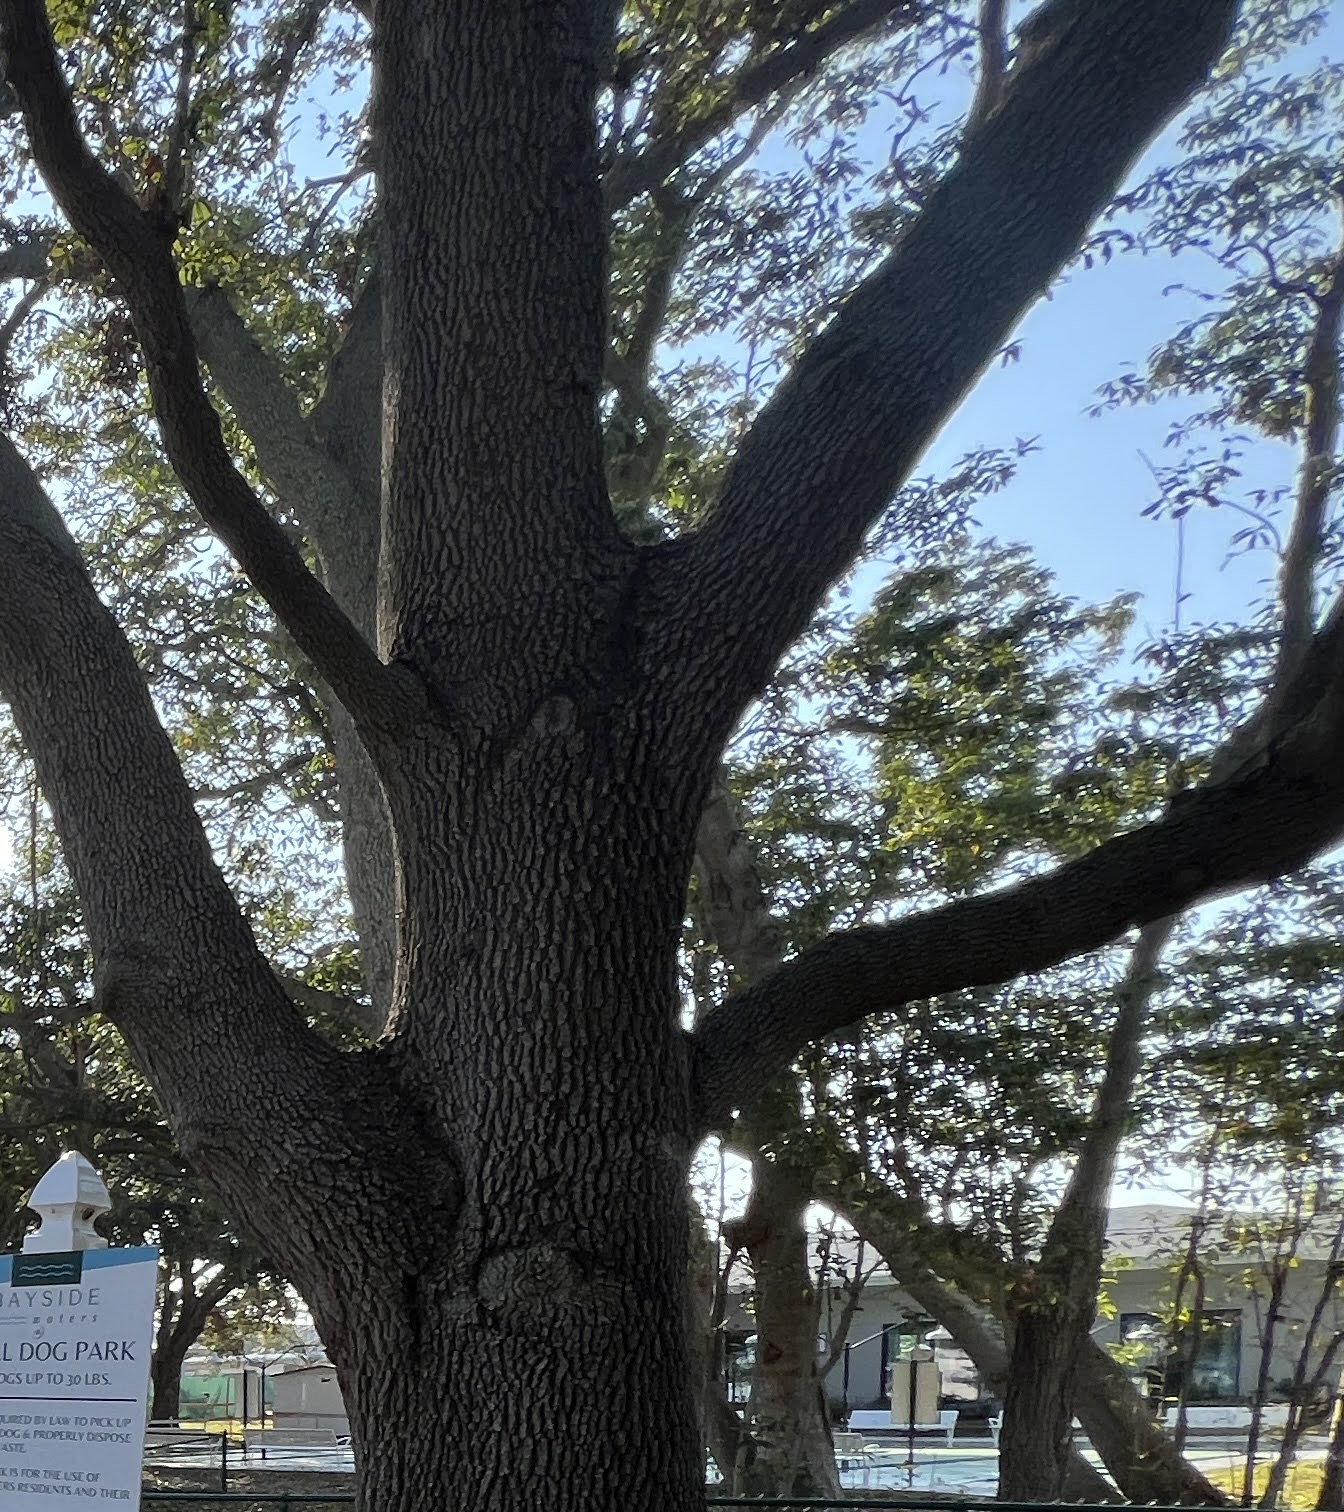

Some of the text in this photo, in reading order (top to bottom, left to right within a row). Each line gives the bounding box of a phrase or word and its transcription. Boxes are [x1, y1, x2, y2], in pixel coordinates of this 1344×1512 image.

[19, 1342, 67, 1361] DOG
[75, 1341, 136, 1360] PARK
[26, 1373, 43, 1384] UP
[46, 1373, 63, 1385] TO
[66, 1374, 81, 1386] 30
[84, 1374, 112, 1386] LBS.
[34, 1416, 47, 1425] BY
[49, 1416, 70, 1426] LAW
[74, 1417, 88, 1426] TO
[90, 1417, 113, 1427] PICK
[116, 1418, 132, 1427] UP
[0, 1429, 20, 1439] DOG
[23, 1430, 31, 1439] &
[34, 1430, 84, 1441] PROPERLY
[86, 1432, 132, 1443] DISPOSE
[10, 1468, 18, 1477] IS
[21, 1469, 40, 1478] FOR
[43, 1470, 61, 1480] THE
[64, 1471, 83, 1481] USE
[86, 1473, 100, 1482] OF
[17, 1483, 71, 1495] RESIDENTS
[74, 1487, 97, 1497] AND
[99, 1488, 130, 1500] THEIR
